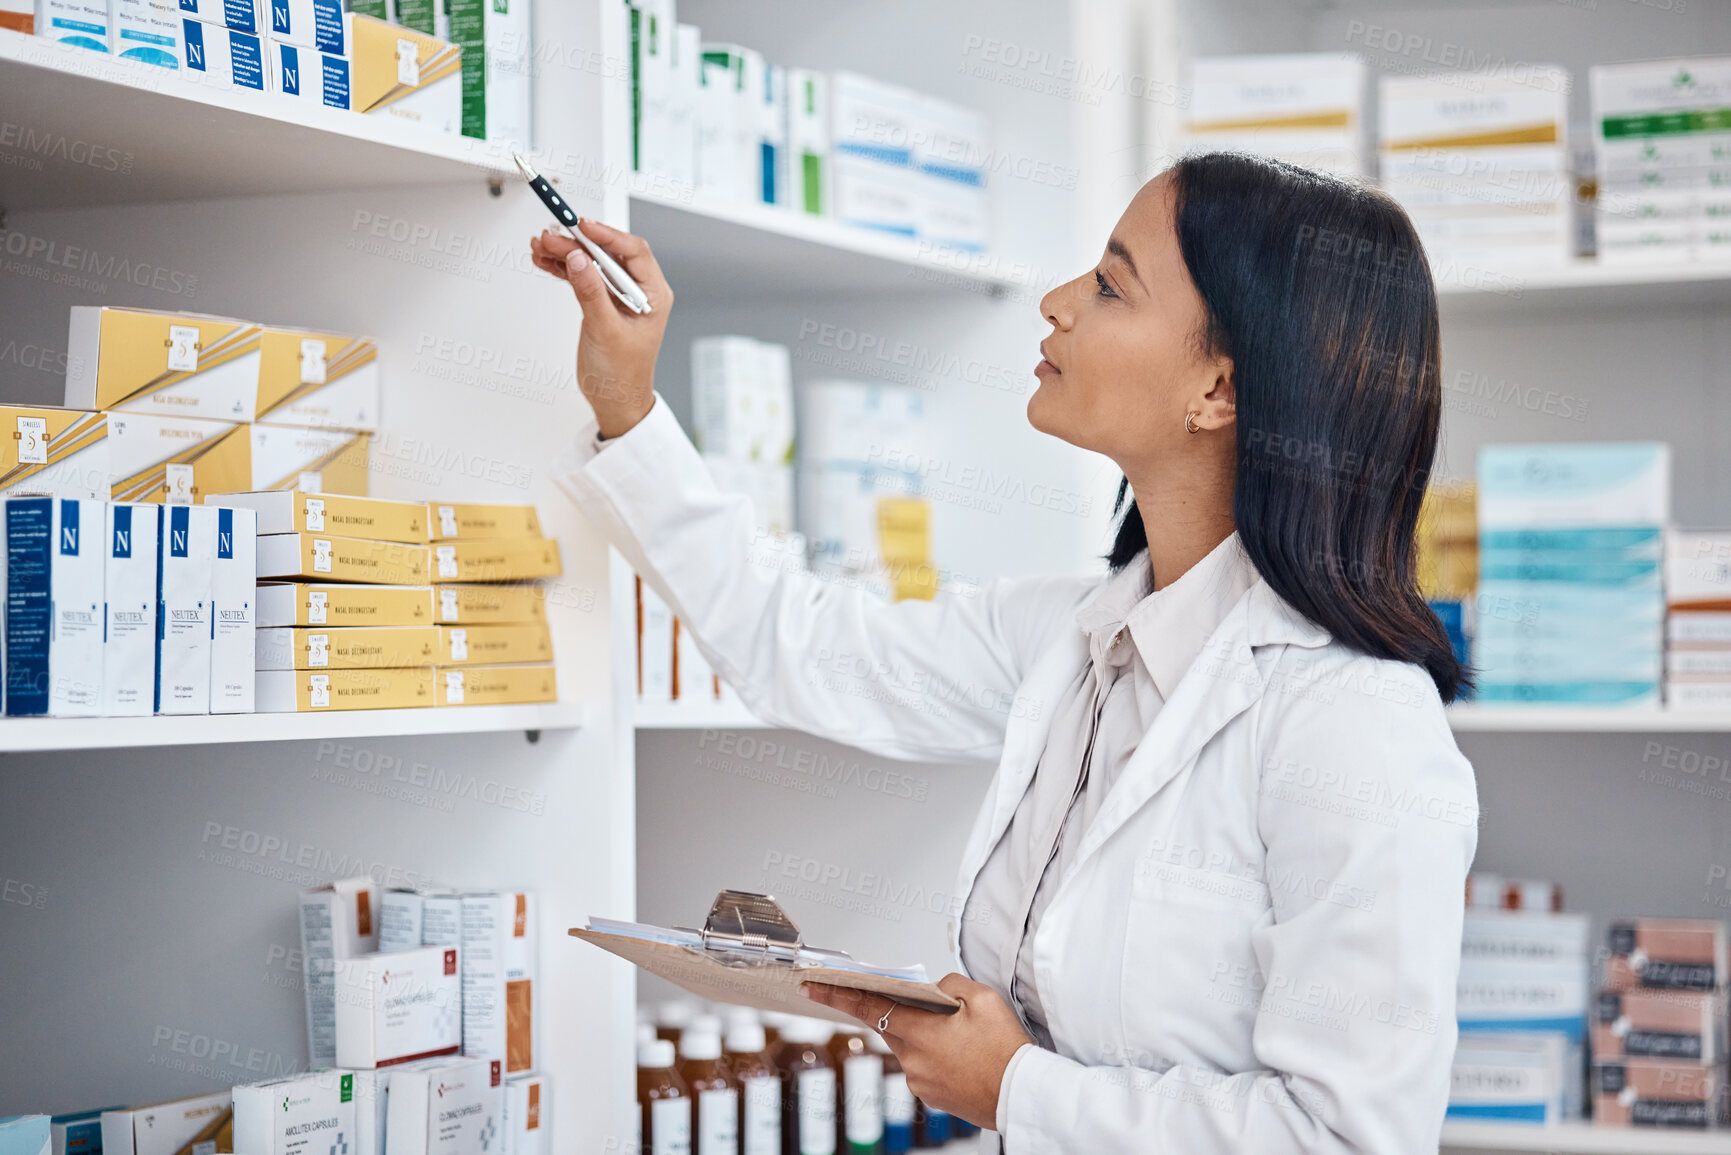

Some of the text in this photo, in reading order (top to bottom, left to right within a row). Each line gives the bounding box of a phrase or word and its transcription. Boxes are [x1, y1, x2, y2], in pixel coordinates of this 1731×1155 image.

[275, 7, 287, 28] N
[188, 43, 201, 64] N
[285, 68, 296, 88] N
[63, 528, 76, 550] N
[116, 531, 128, 551] N
[174, 530, 185, 550] N
[220, 532, 230, 552] N
[114, 612, 143, 622] NEUTEX
[171, 610, 199, 620] NEUTEX
[220, 610, 245, 620] NEUTEX
